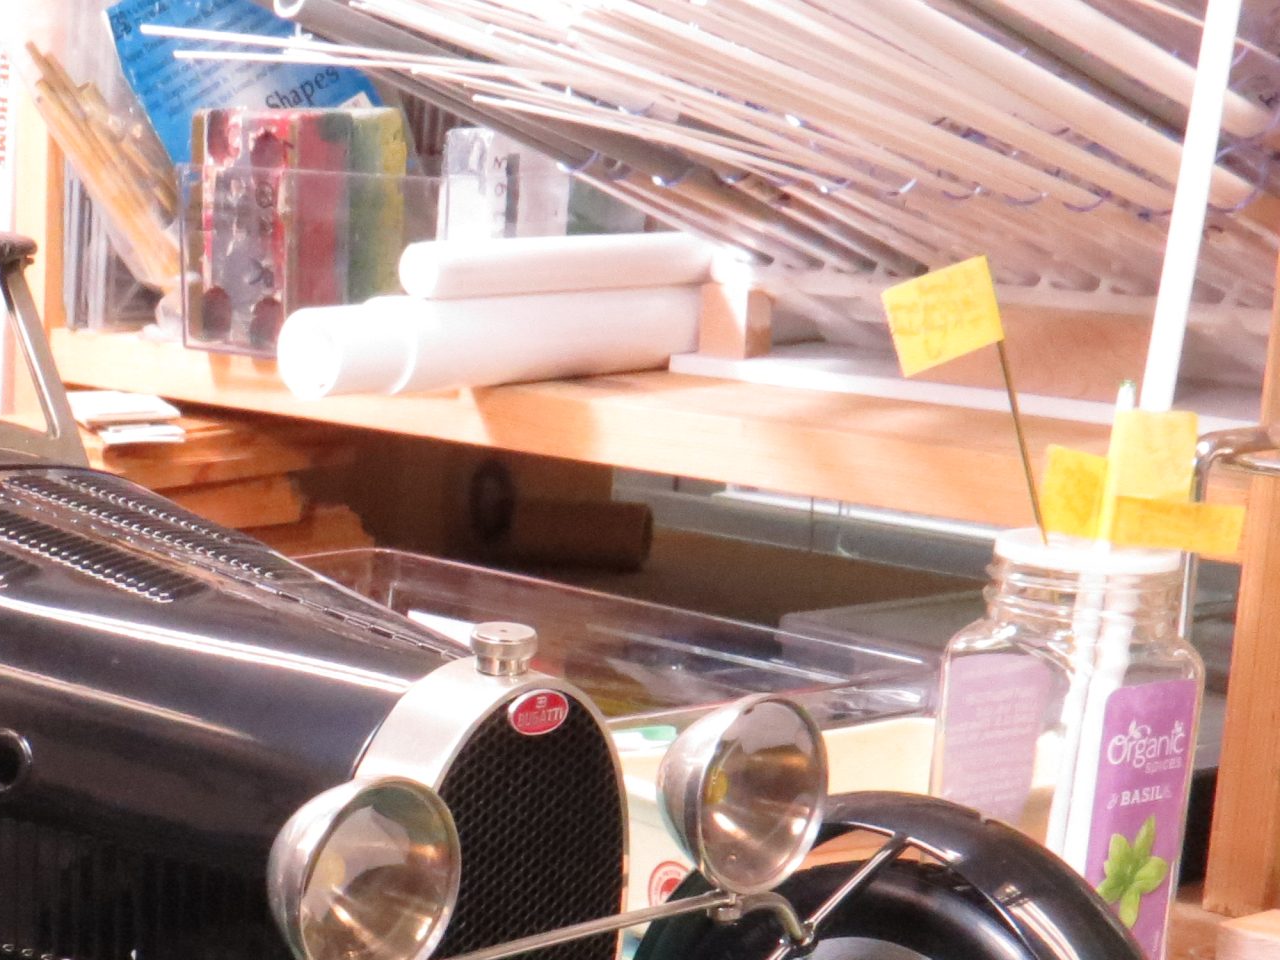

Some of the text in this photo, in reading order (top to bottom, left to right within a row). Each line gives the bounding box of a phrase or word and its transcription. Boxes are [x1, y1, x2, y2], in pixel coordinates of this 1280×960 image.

[265, 66, 340, 108] Shapes
[1107, 722, 1186, 768] Organic
[1120, 785, 1163, 806] BASIL
